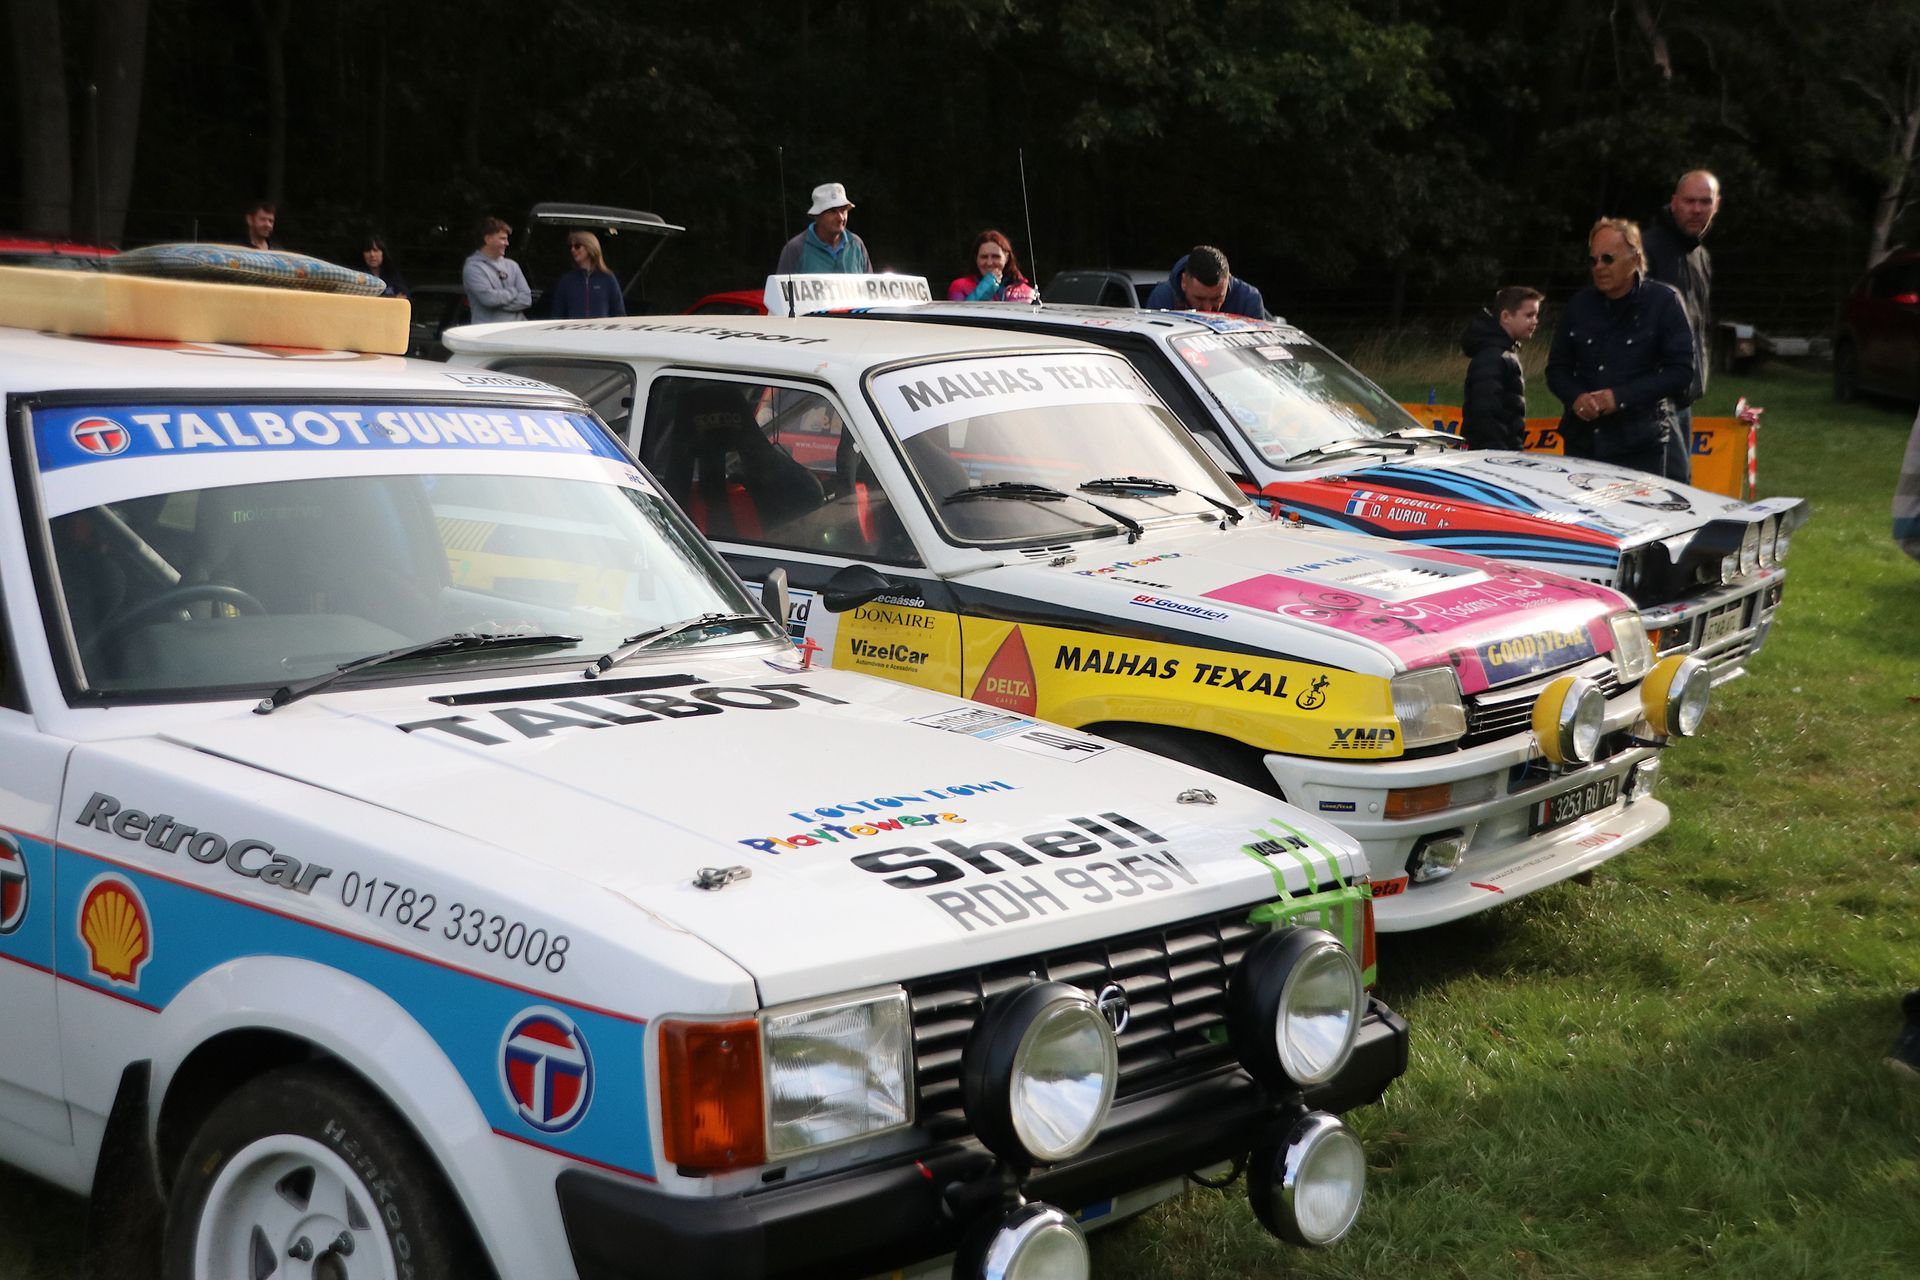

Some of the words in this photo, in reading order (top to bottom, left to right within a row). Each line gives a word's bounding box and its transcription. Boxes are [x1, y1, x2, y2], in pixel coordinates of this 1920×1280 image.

[866, 279, 929, 302] RACING
[898, 367, 1044, 413] MALHAS
[1042, 366, 1134, 391] TEXAL
[131, 410, 371, 450] TALBOT
[376, 411, 594, 451] SUNBEAM
[1372, 504, 1383, 518] D.
[1387, 507, 1428, 526] AURIOL
[854, 607, 936, 630] DONAIRE
[1132, 594, 1230, 620] BFGoodrich
[850, 638, 929, 665] VizelCar
[1053, 645, 1180, 680] MALHAS
[1192, 663, 1290, 699] TEXAL
[985, 677, 1031, 698] DELTA
[394, 683, 851, 746] TALBOT
[1328, 728, 1396, 750] XMP
[788, 793, 930, 823] BOSTON
[1554, 790, 1583, 823] 3253
[1585, 783, 1600, 812] RU
[1600, 778, 1616, 807] 74
[737, 811, 968, 855] Playtowers
[850, 811, 1169, 890] Shell
[75, 791, 334, 896] RetroCar
[341, 870, 438, 932] 01782
[443, 902, 571, 973] 333008
[926, 876, 1071, 932] RDH
[1054, 850, 1199, 904] 935V
